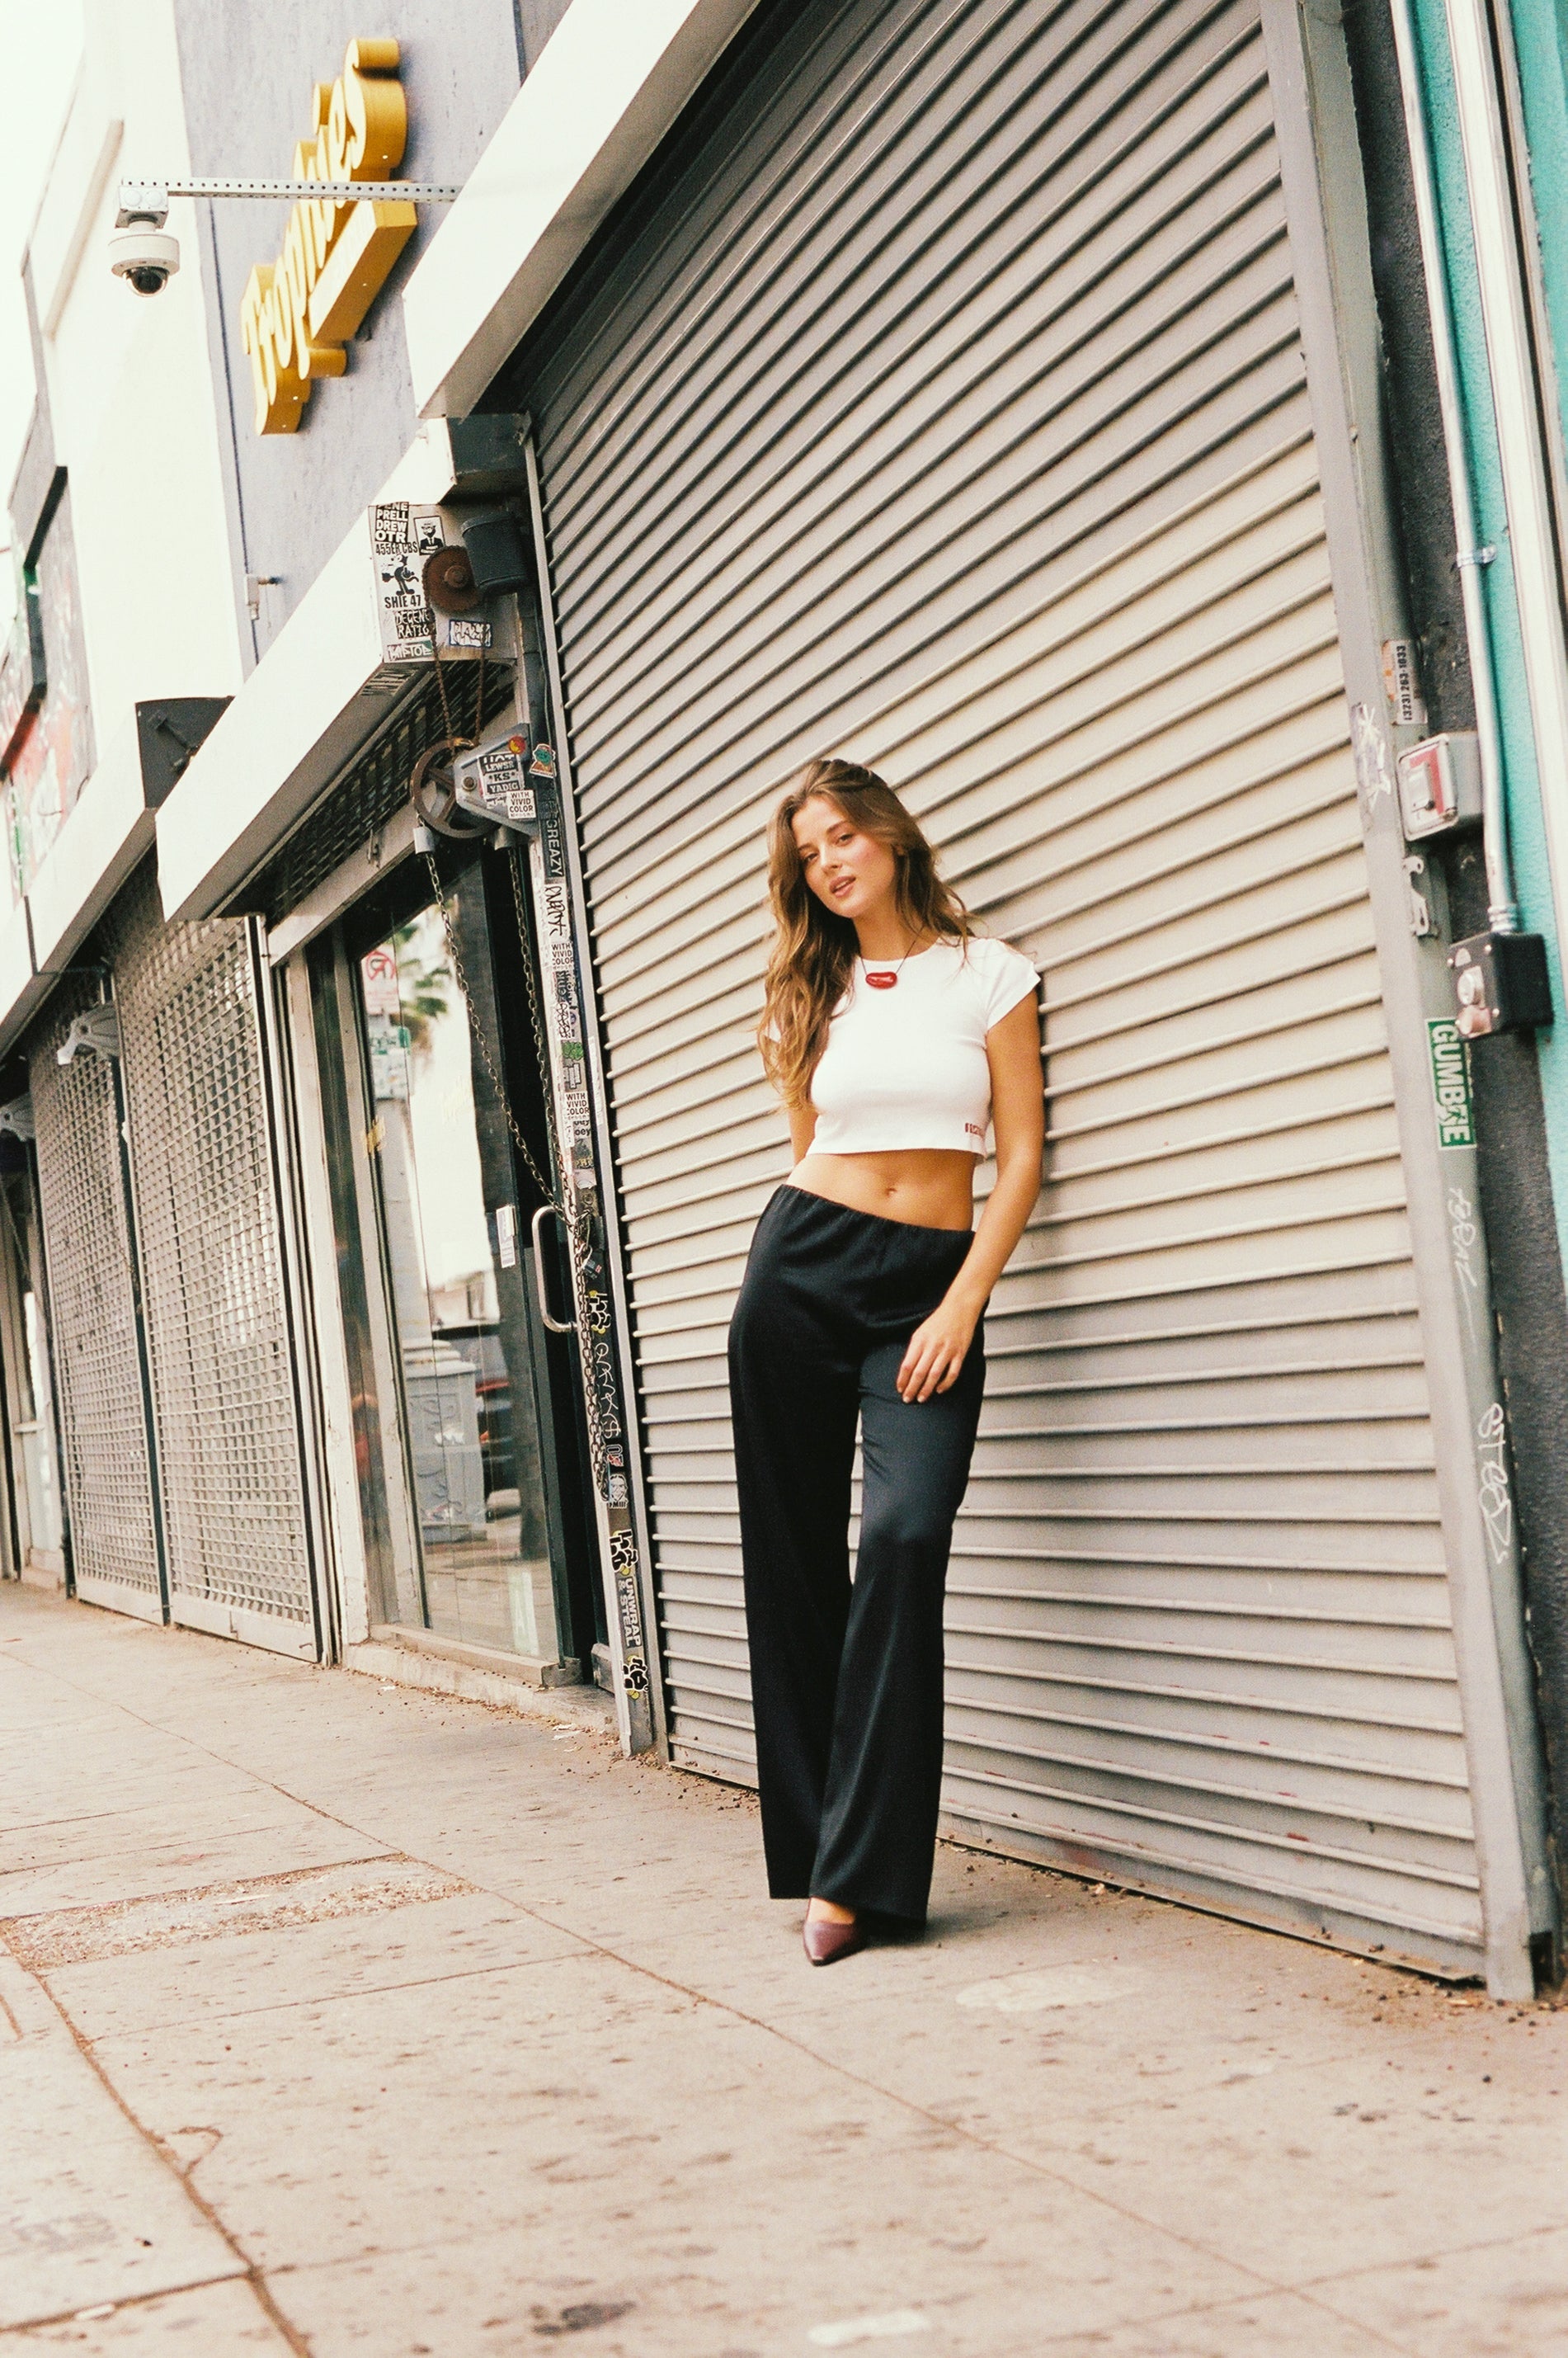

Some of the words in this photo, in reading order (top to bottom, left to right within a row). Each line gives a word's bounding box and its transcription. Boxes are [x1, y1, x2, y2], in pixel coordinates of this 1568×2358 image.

[377, 510, 408, 521] PRELL
[376, 521, 407, 532] DREW
[375, 531, 406, 544] OTR
[490, 782, 519, 793] YADIG
[510, 805, 534, 814] COLOR
[546, 819, 563, 876] GREAZY
[552, 942, 571, 950] WITH
[566, 1093, 586, 1101] WITH
[625, 1578, 642, 1647] UNWRAP
[619, 1596, 633, 1648] STEAL
